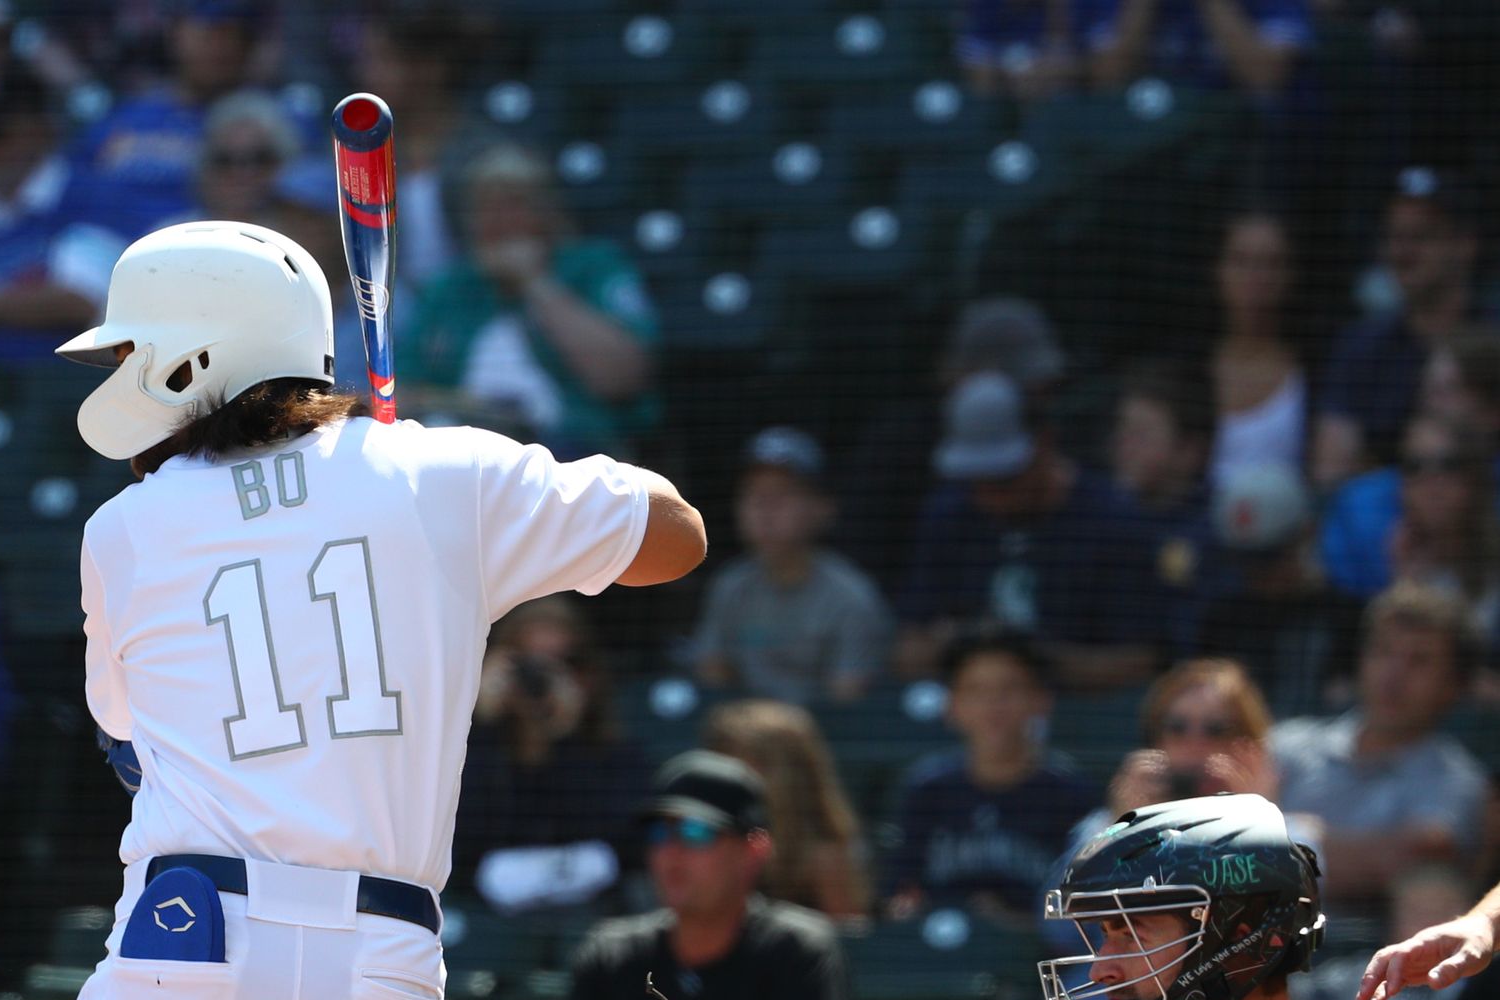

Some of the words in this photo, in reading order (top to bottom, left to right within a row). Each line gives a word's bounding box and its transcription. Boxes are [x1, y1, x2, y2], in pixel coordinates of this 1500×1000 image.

[230, 450, 308, 520] BO
[202, 536, 403, 761] 11
[1203, 853, 1260, 886] JASE
[1177, 972, 1195, 987] WE
[1193, 962, 1213, 976] LOVE
[1211, 949, 1230, 963] YOU
[1231, 930, 1263, 953] DADDY
